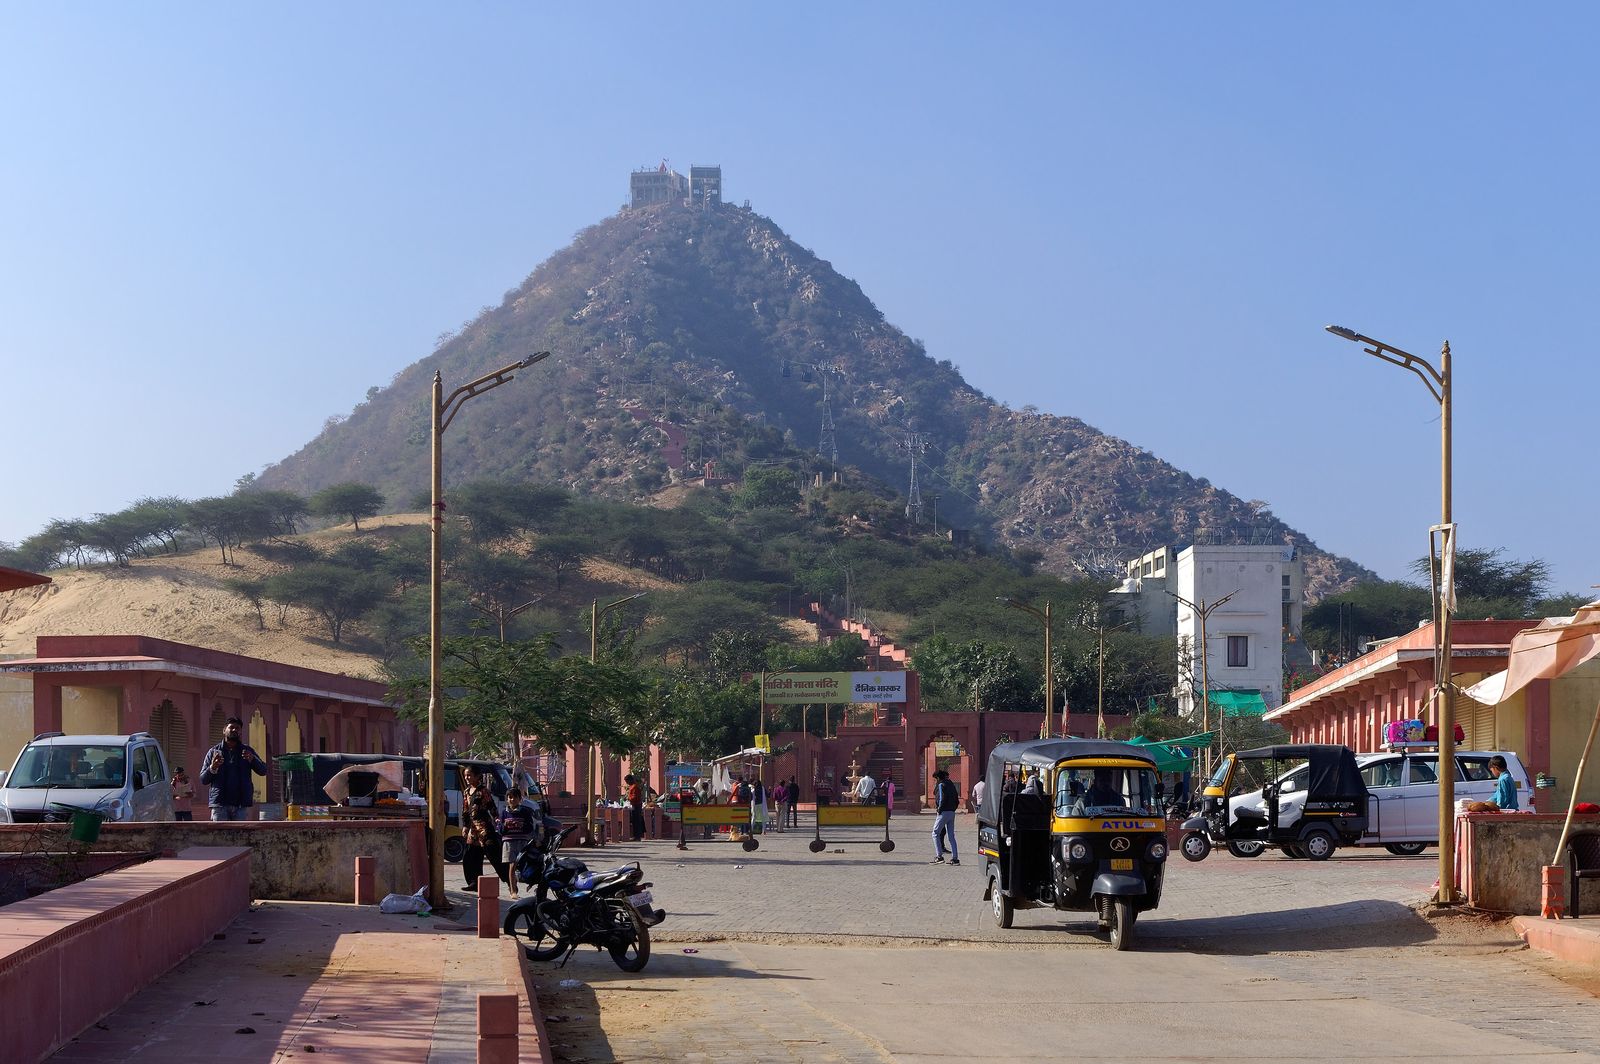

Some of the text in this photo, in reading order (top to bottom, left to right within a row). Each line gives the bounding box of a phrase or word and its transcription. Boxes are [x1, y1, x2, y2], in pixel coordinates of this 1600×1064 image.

[793, 680, 814, 689] माता
[815, 677, 839, 689] मंदिर
[855, 683, 876, 692] दैनिक
[1102, 821, 1144, 829] ATUL
